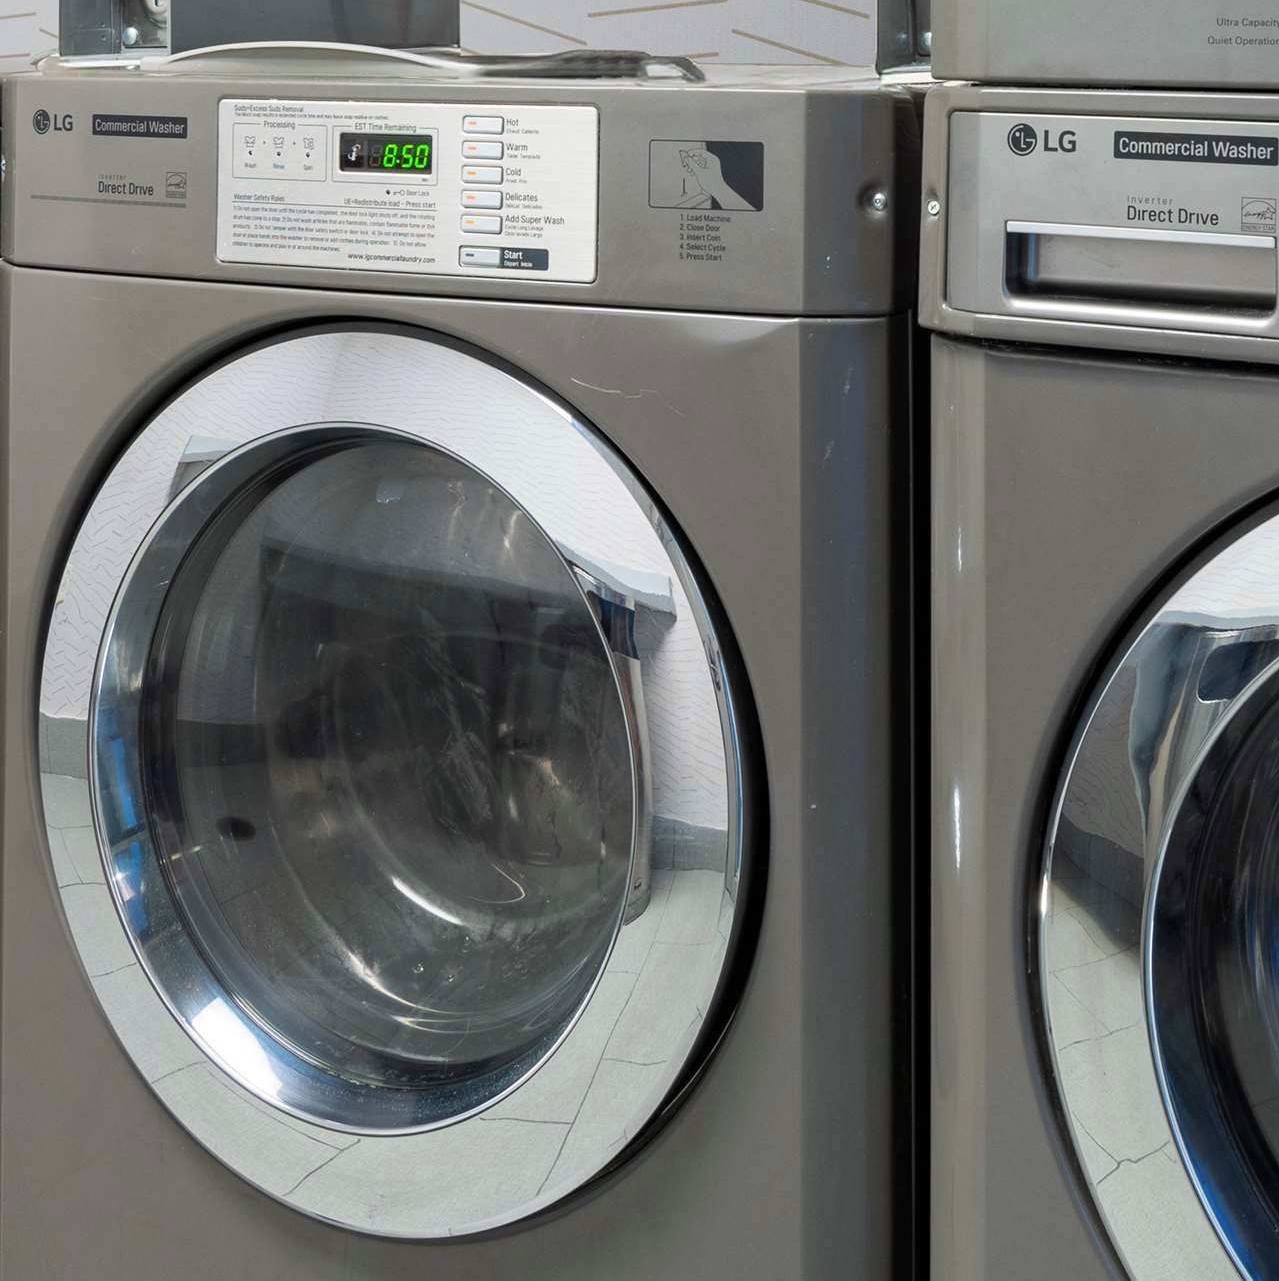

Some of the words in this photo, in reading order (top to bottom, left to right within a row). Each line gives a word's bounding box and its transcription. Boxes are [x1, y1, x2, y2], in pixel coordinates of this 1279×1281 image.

[1216, 18, 1239, 27] Ultra
[1207, 36, 1232, 46] Quiet
[54, 114, 73, 131] LG
[95, 119, 147, 132] Commercial
[149, 121, 184, 134] Washer
[264, 120, 295, 130] Processing
[384, 123, 416, 133] Remaining
[1043, 130, 1077, 153] LG
[1119, 137, 1209, 157] Commercial
[1212, 141, 1274, 160] Washer
[383, 143, 429, 168] 8.50
[505, 168, 521, 176] Cold
[98, 181, 126, 194] Direct
[129, 182, 154, 196] Drive
[505, 193, 538, 202] Delicates
[1127, 196, 1173, 205] Inverter
[505, 215, 520, 223] Add
[521, 216, 542, 226] Super
[544, 216, 565, 224] Wash
[1127, 206, 1173, 224] Direct
[1178, 208, 1219, 226] Drive
[504, 250, 523, 259] Start
